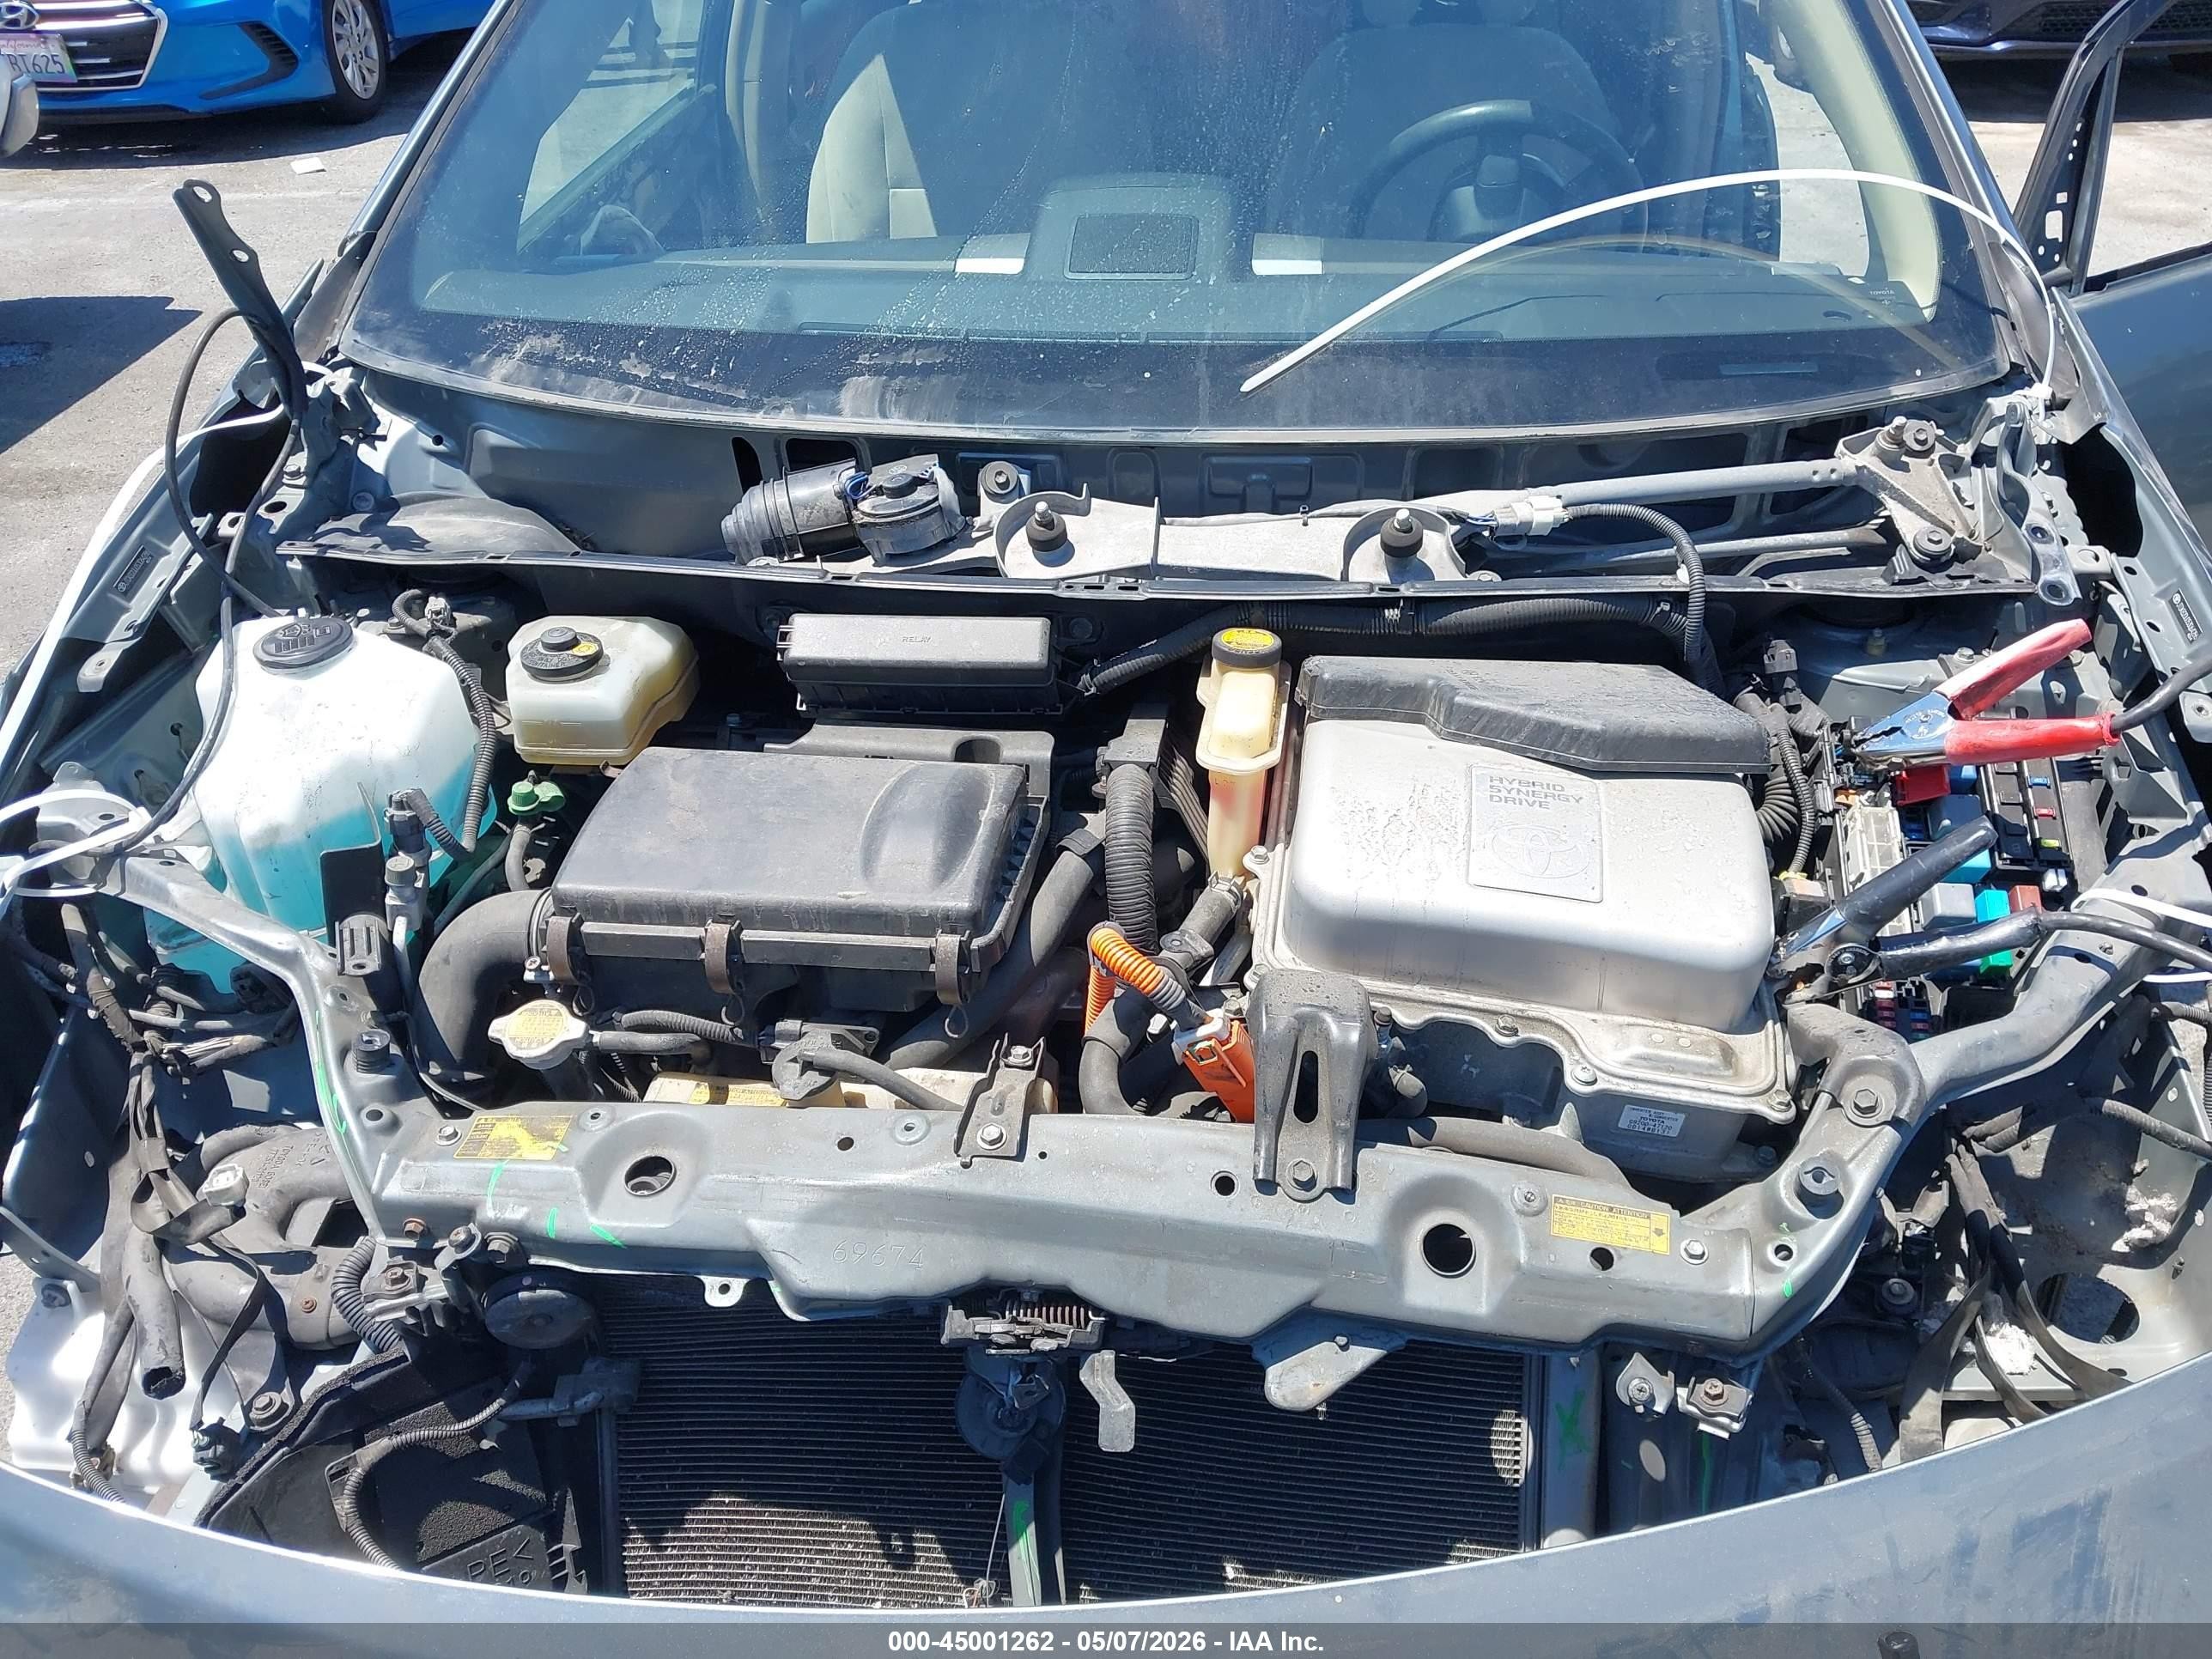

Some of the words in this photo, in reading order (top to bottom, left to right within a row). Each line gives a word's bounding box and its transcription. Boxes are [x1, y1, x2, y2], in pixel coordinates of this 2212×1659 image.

[1, 53, 65, 75] RT625
[1489, 775, 1565, 792] HYBRID
[1489, 785, 1583, 804] SYNERGY
[1489, 794, 1550, 810] DRIVE
[1580, 1202, 1610, 1213] CAUTION
[832, 1239, 925, 1270] 69674
